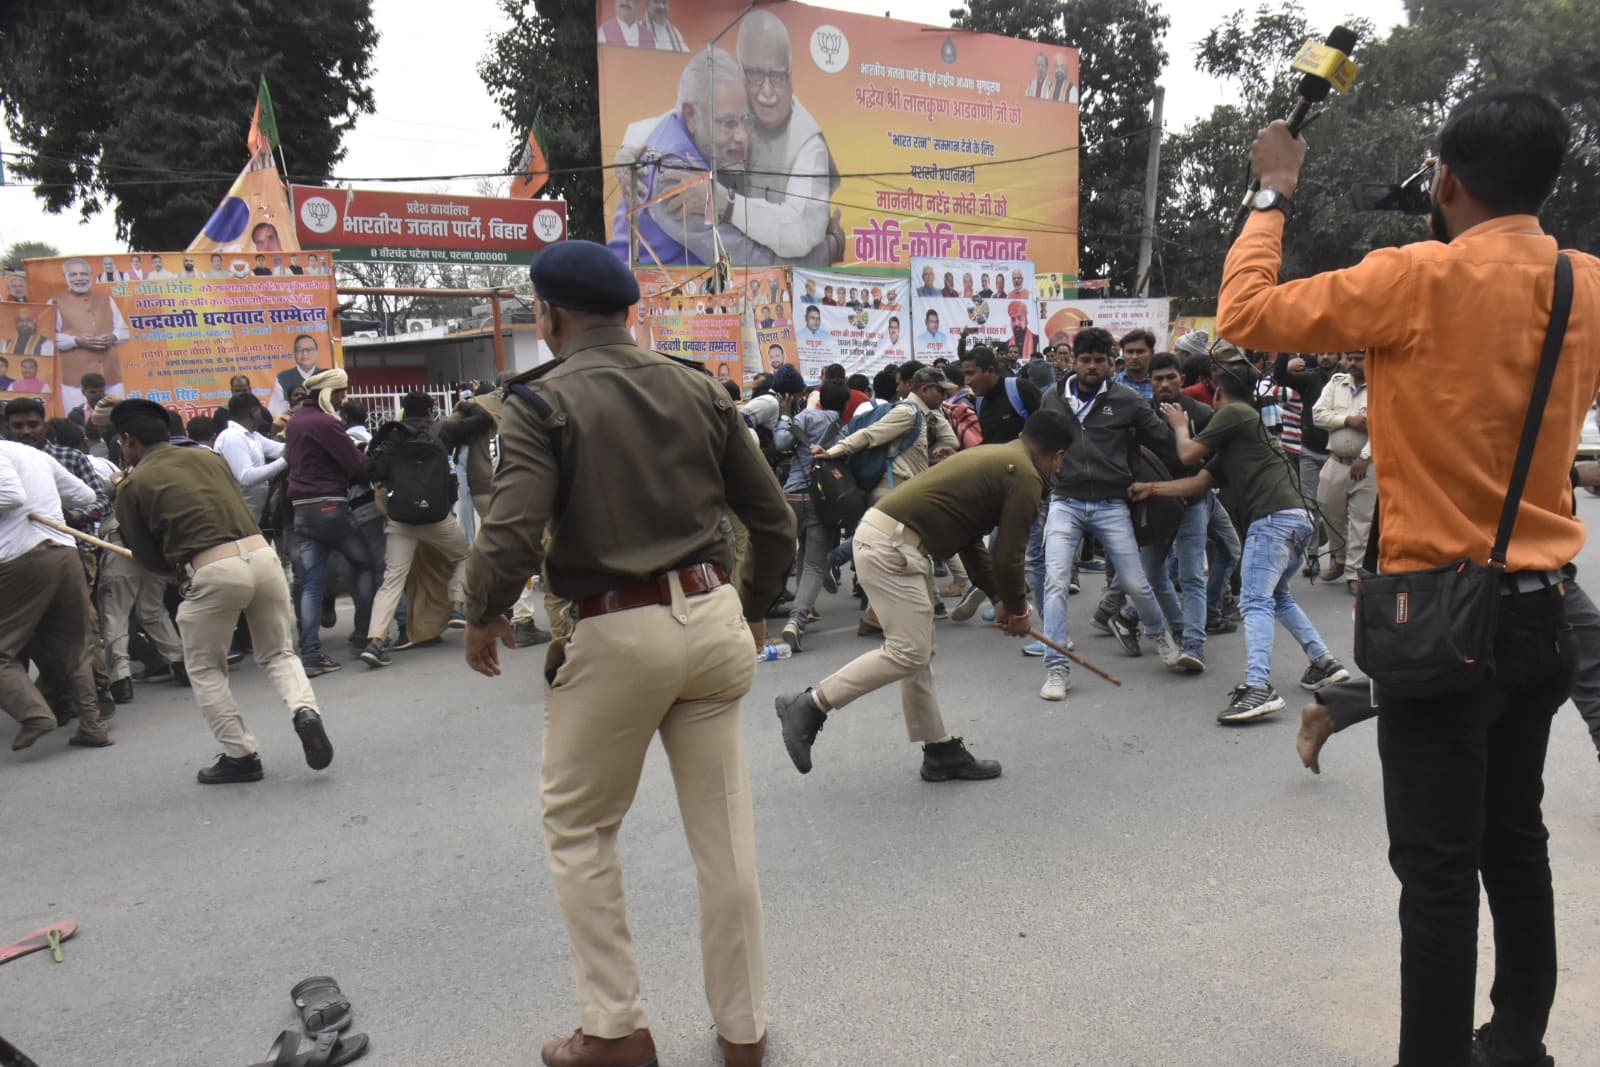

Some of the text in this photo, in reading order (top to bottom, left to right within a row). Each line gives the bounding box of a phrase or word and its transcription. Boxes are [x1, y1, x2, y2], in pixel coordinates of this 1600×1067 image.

[887, 87, 900, 111] श्री
[903, 94, 949, 121] लालकृष्ण
[953, 99, 993, 121] आडवाणी
[995, 102, 1007, 123] जी
[1009, 105, 1021, 125] को
[934, 138, 959, 153] सम्मान
[961, 138, 972, 154] देने
[973, 139, 980, 154] के
[981, 140, 995, 157] लिए
[406, 200, 469, 216] प्रदेश कार्यालय
[876, 187, 1009, 218] माननीय नरेंद्र मोदी जी को
[343, 212, 528, 241] भारतीय जनता पार्टी, बिहार
[409, 247, 429, 259] पटेल
[129, 305, 326, 330] चन्द्रवंशी धन्यवाद सम्मेलन
